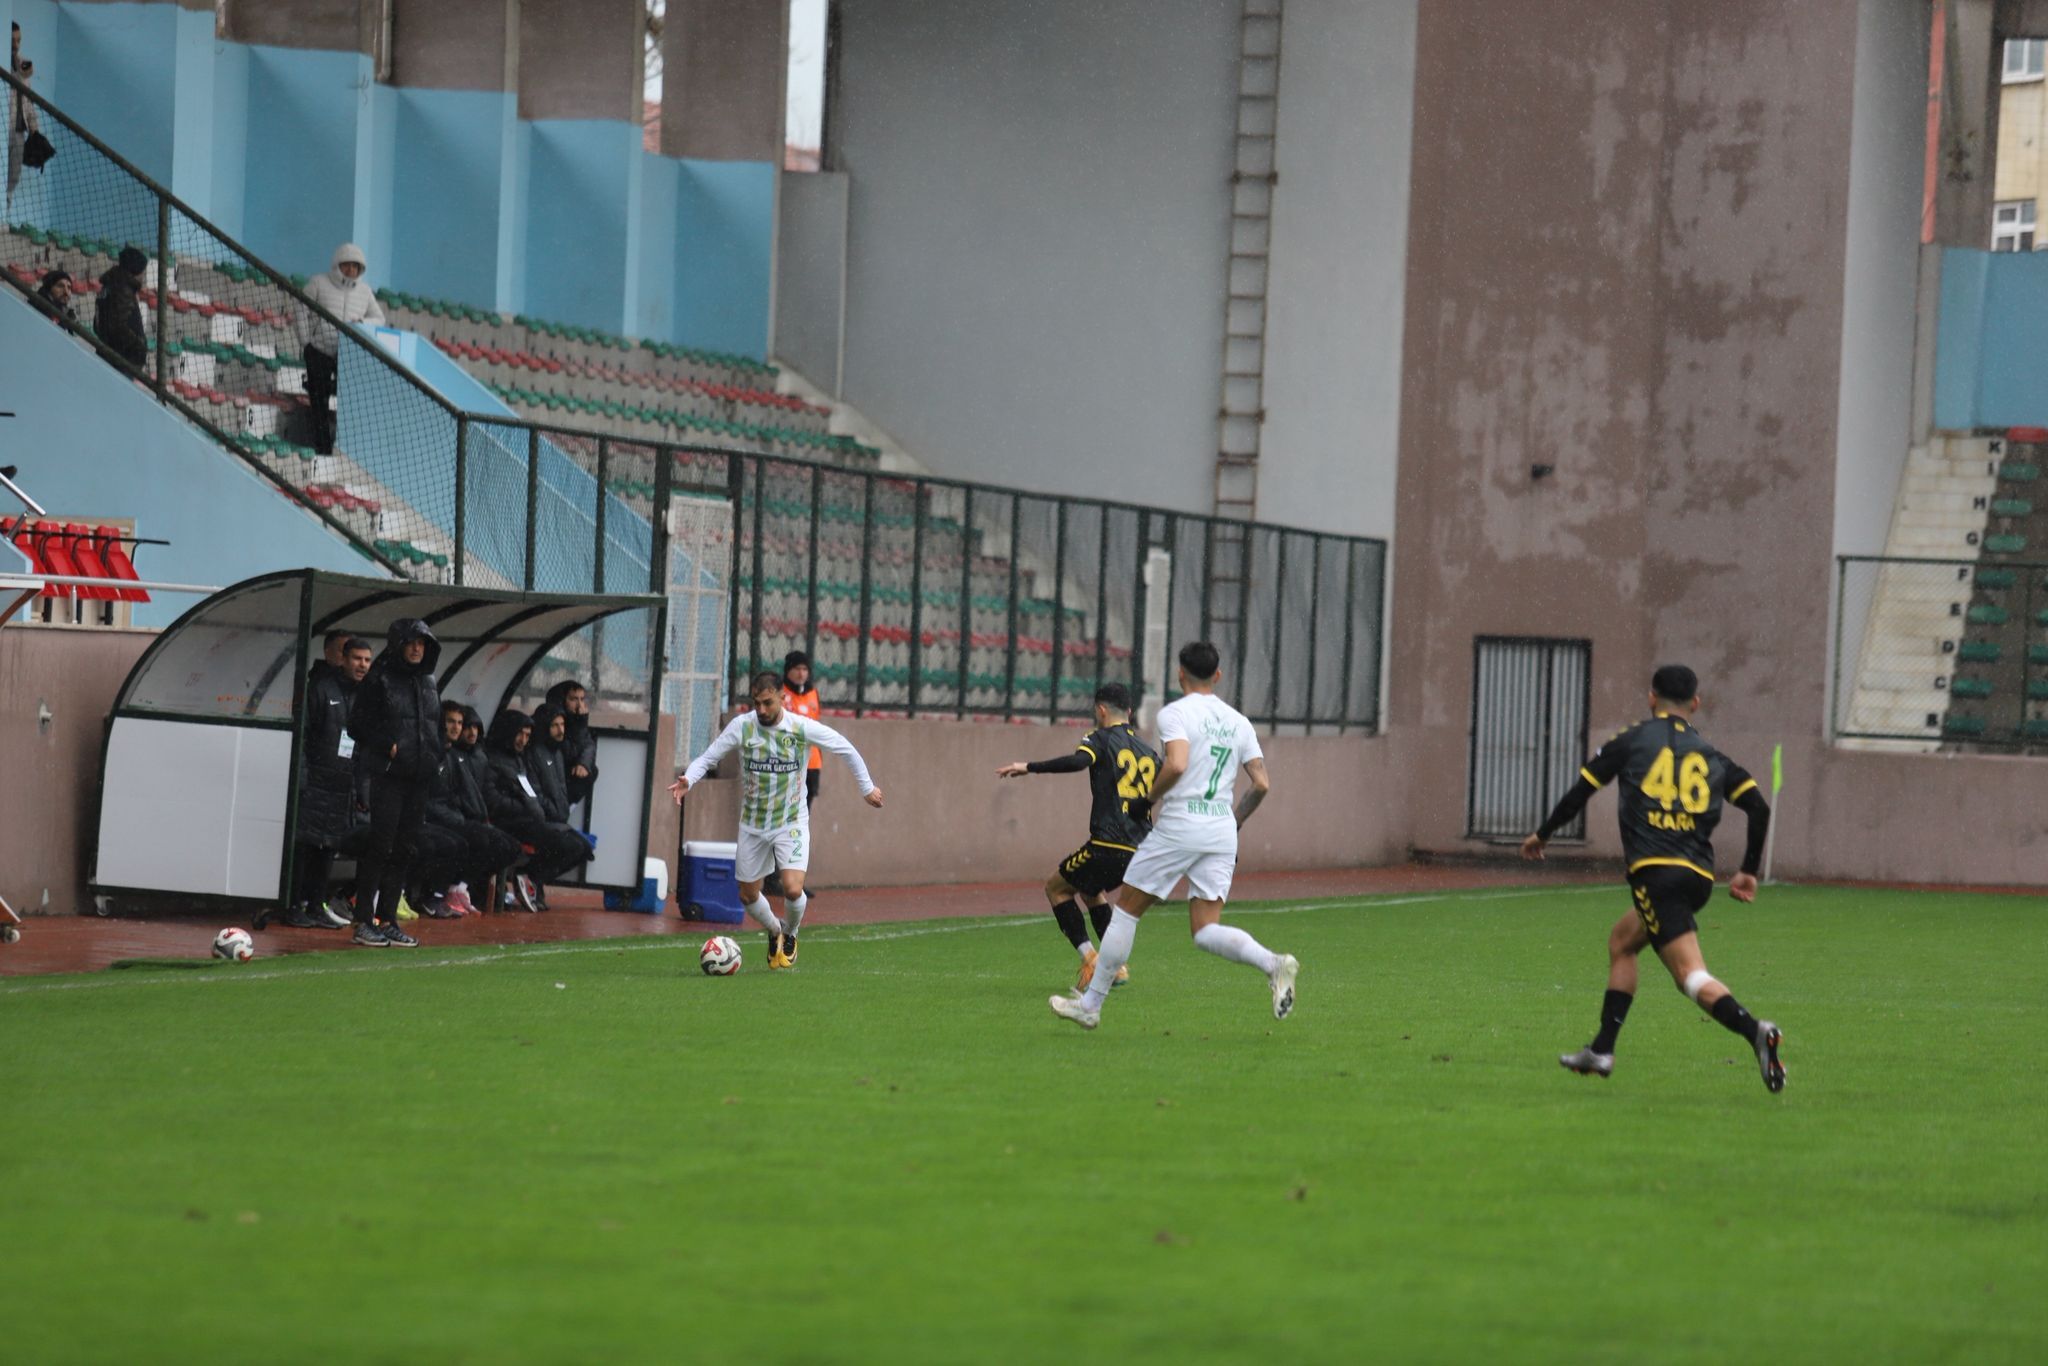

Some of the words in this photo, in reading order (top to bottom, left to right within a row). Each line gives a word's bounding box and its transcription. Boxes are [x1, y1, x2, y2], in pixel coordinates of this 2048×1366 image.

[1989, 441, 2001, 454] K
[1973, 496, 1986, 510] H
[1958, 569, 1968, 581] F
[1951, 603, 1961, 616] E
[1942, 640, 1954, 653] D
[1934, 676, 1946, 689] C
[1204, 745, 1232, 800] 7
[1641, 746, 1710, 813] 46
[792, 840, 803, 857] 2
